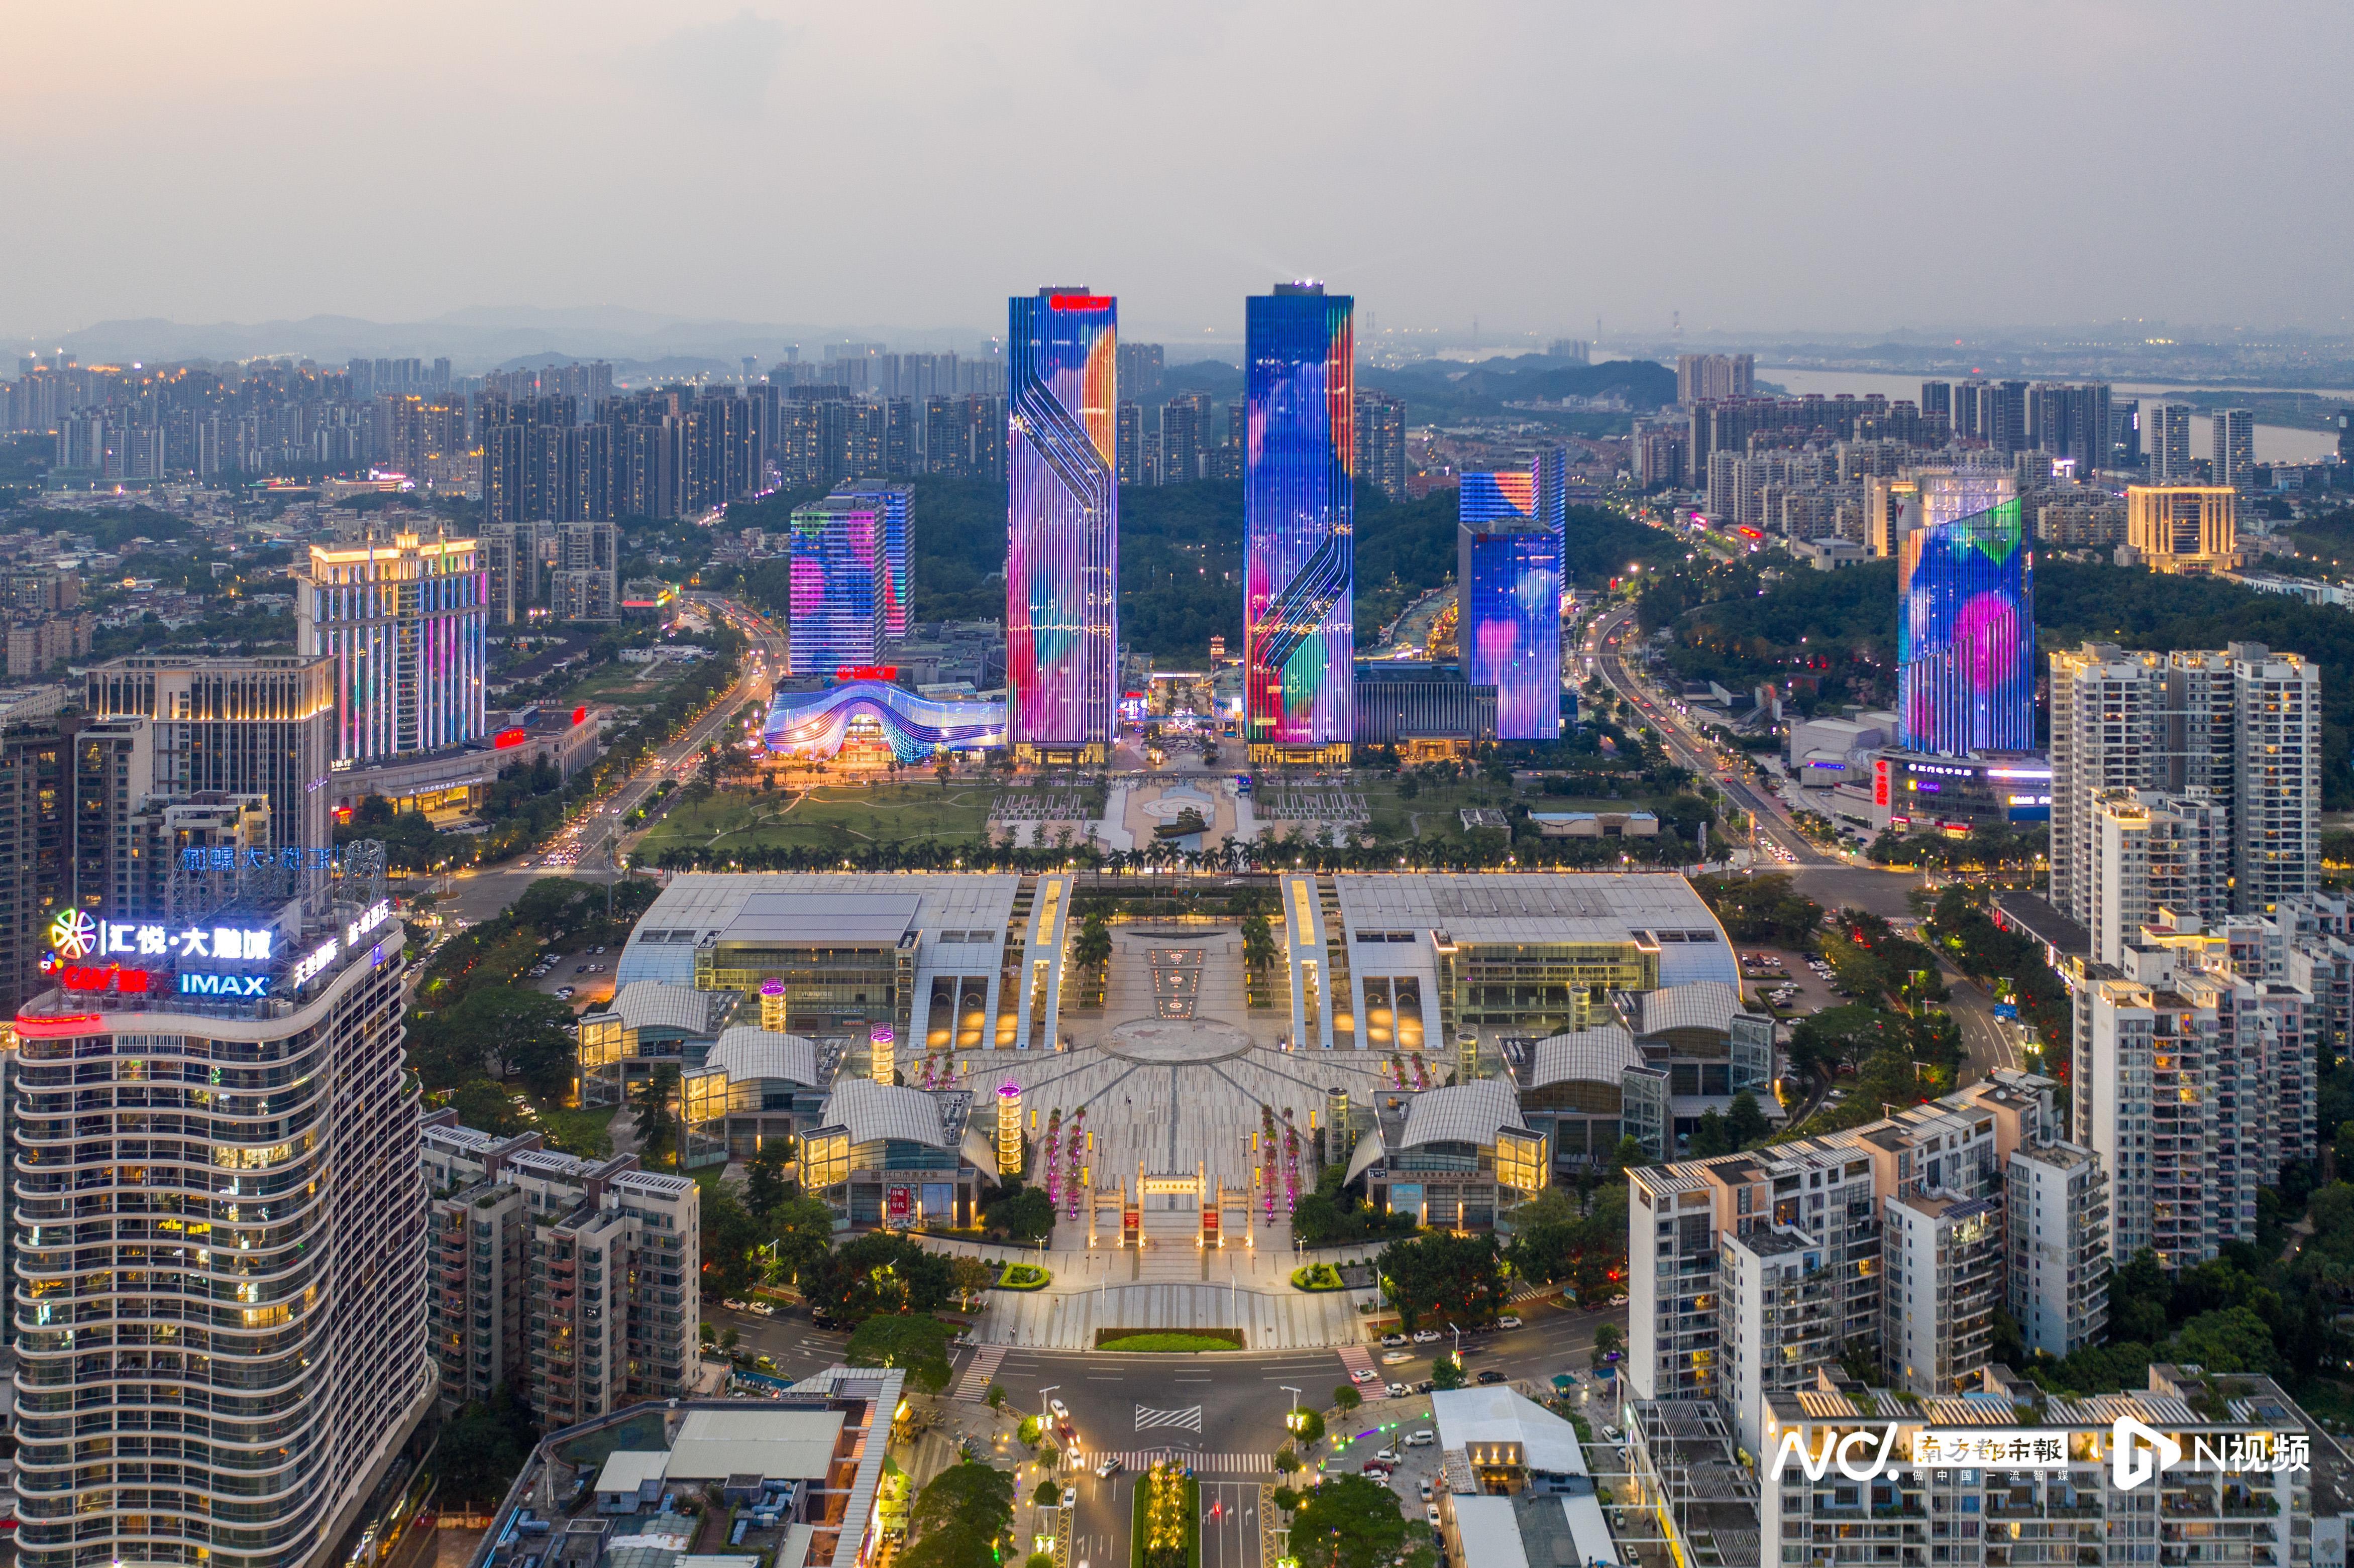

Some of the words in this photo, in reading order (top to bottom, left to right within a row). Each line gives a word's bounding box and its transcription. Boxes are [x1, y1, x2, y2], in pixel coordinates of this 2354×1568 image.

[109, 925, 272, 960] 汇悦·大融城
[63, 966, 115, 990] CGV
[181, 973, 267, 996] IMAX
